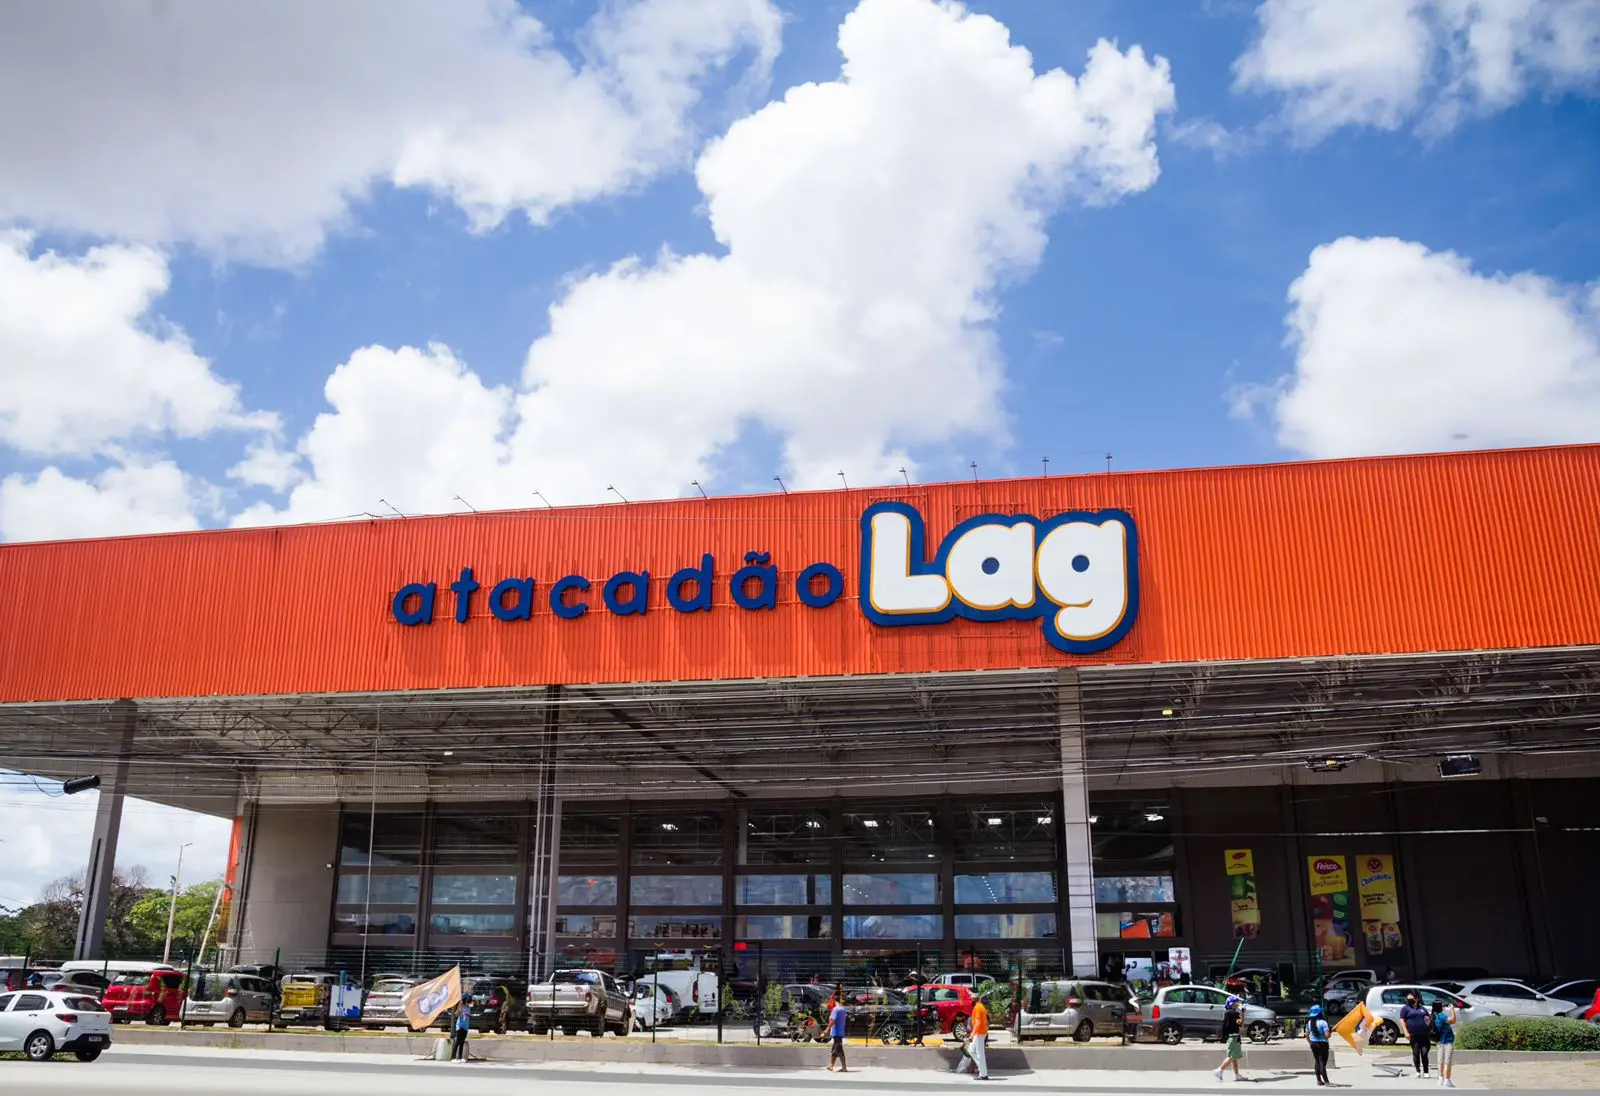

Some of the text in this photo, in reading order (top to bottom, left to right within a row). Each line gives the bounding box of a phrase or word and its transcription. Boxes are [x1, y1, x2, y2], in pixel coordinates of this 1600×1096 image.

[392, 509, 1131, 643] atacadão Lag
[1316, 862, 1338, 871] Frisco
